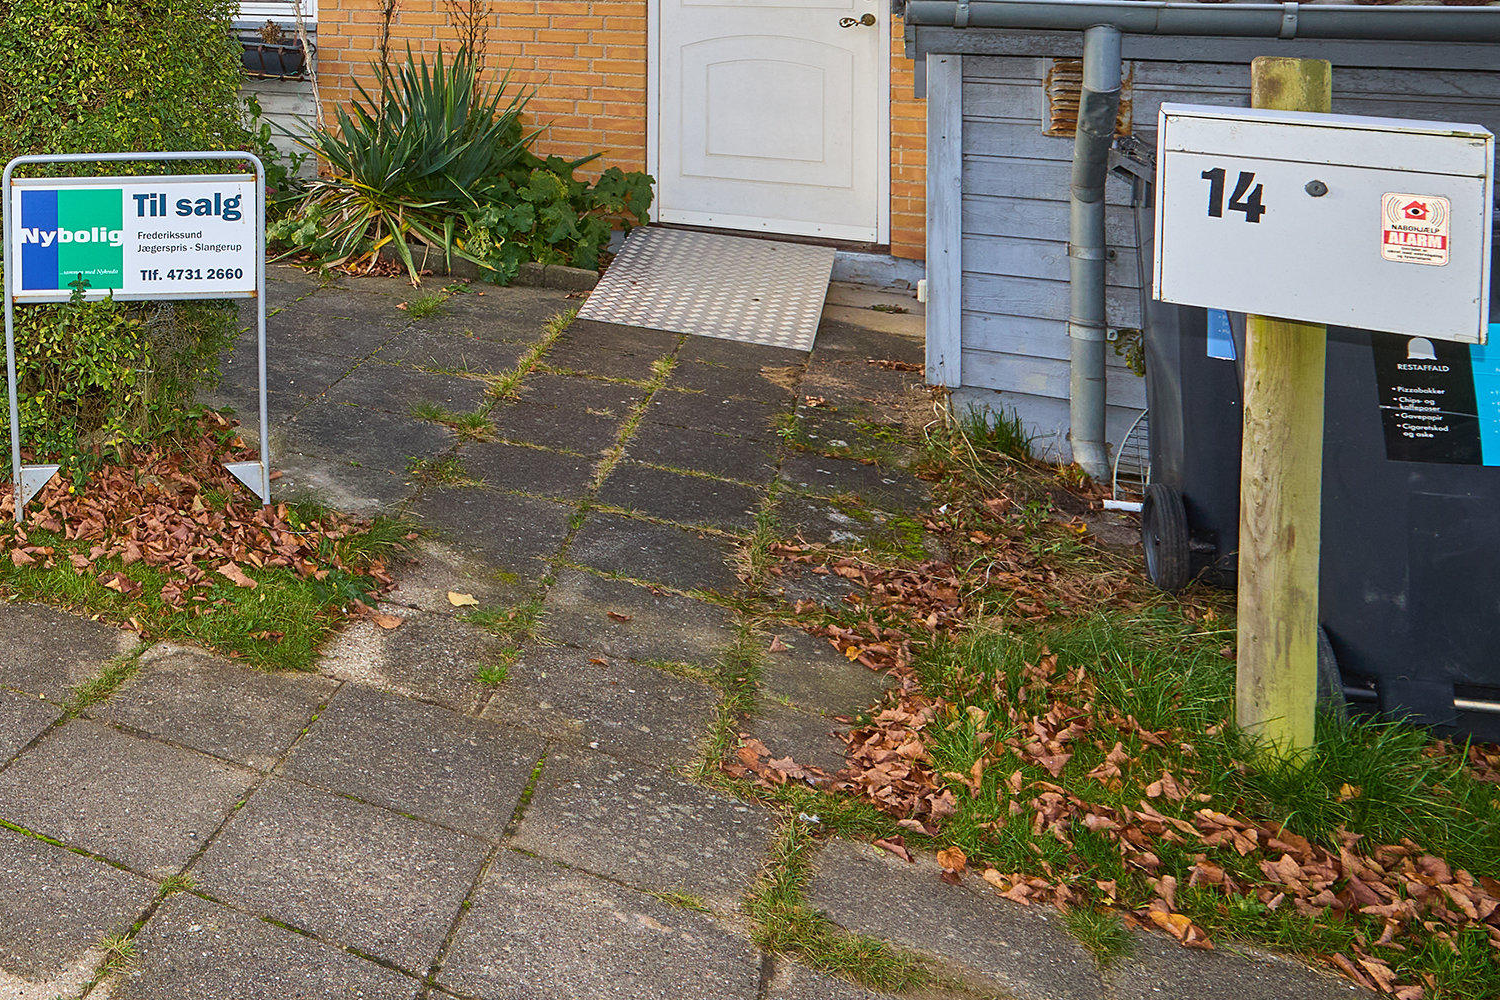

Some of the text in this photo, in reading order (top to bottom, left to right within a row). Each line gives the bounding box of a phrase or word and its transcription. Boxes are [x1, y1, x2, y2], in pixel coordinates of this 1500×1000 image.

[1201, 167, 1266, 223] 14
[132, 193, 242, 221] Til salg
[1391, 224, 1440, 233] NABOHJÆLP
[20, 227, 124, 248] Nybolig
[137, 231, 203, 240] Frederikssund
[1388, 231, 1442, 249] ALARM
[137, 243, 188, 254] Jægerspris
[195, 243, 242, 253] Slangerup
[140, 268, 243, 281] Tlf. 4731 2660
[1397, 363, 1450, 372] RESTAFFALD
